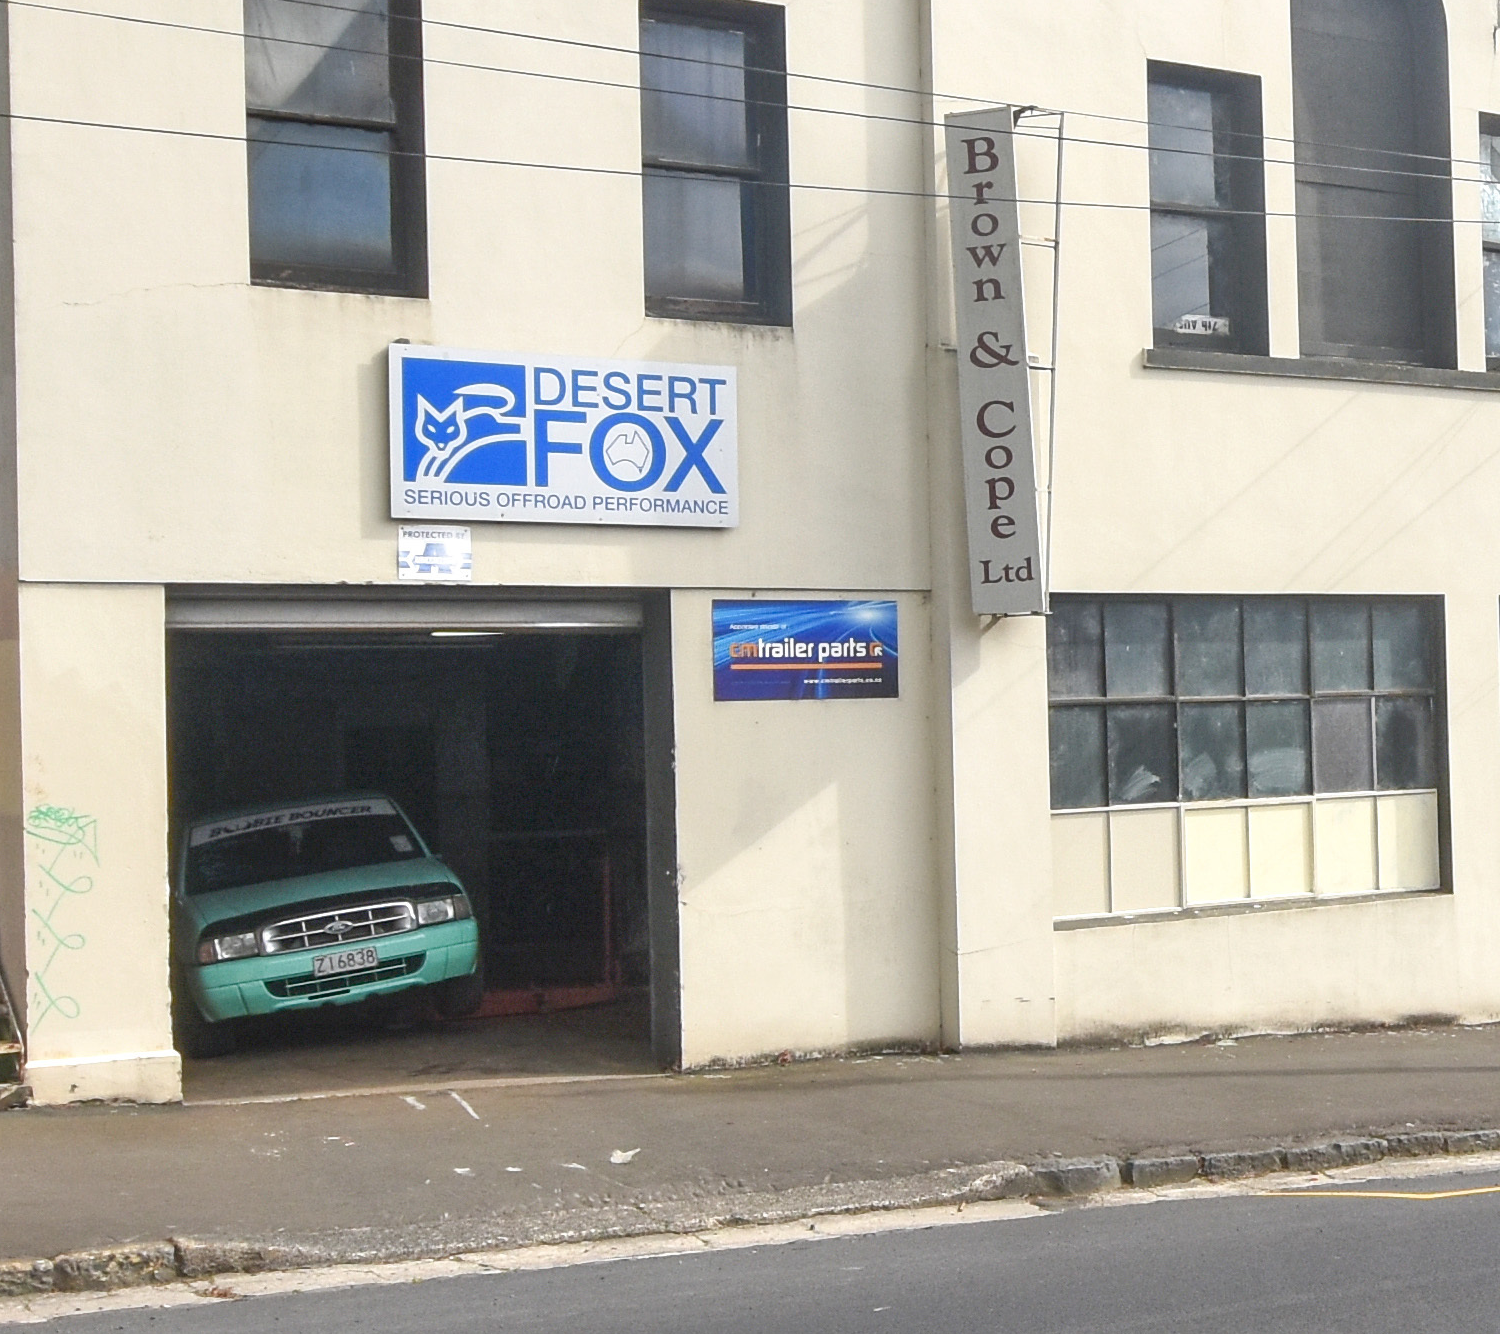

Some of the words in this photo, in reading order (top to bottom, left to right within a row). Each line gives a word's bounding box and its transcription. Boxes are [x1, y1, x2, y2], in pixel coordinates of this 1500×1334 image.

[960, 136, 1007, 303] Brown
[969, 330, 1020, 369] &
[533, 367, 726, 415] DESERT
[533, 412, 727, 494] FOX
[975, 399, 1017, 539] Cope
[403, 488, 491, 508] SERIOUS
[496, 492, 587, 512] OFFROAD
[592, 495, 729, 516] PERFORMANCE
[403, 530, 453, 539] PROTECTED
[979, 556, 1034, 586] Ltd
[818, 637, 867, 663] parts
